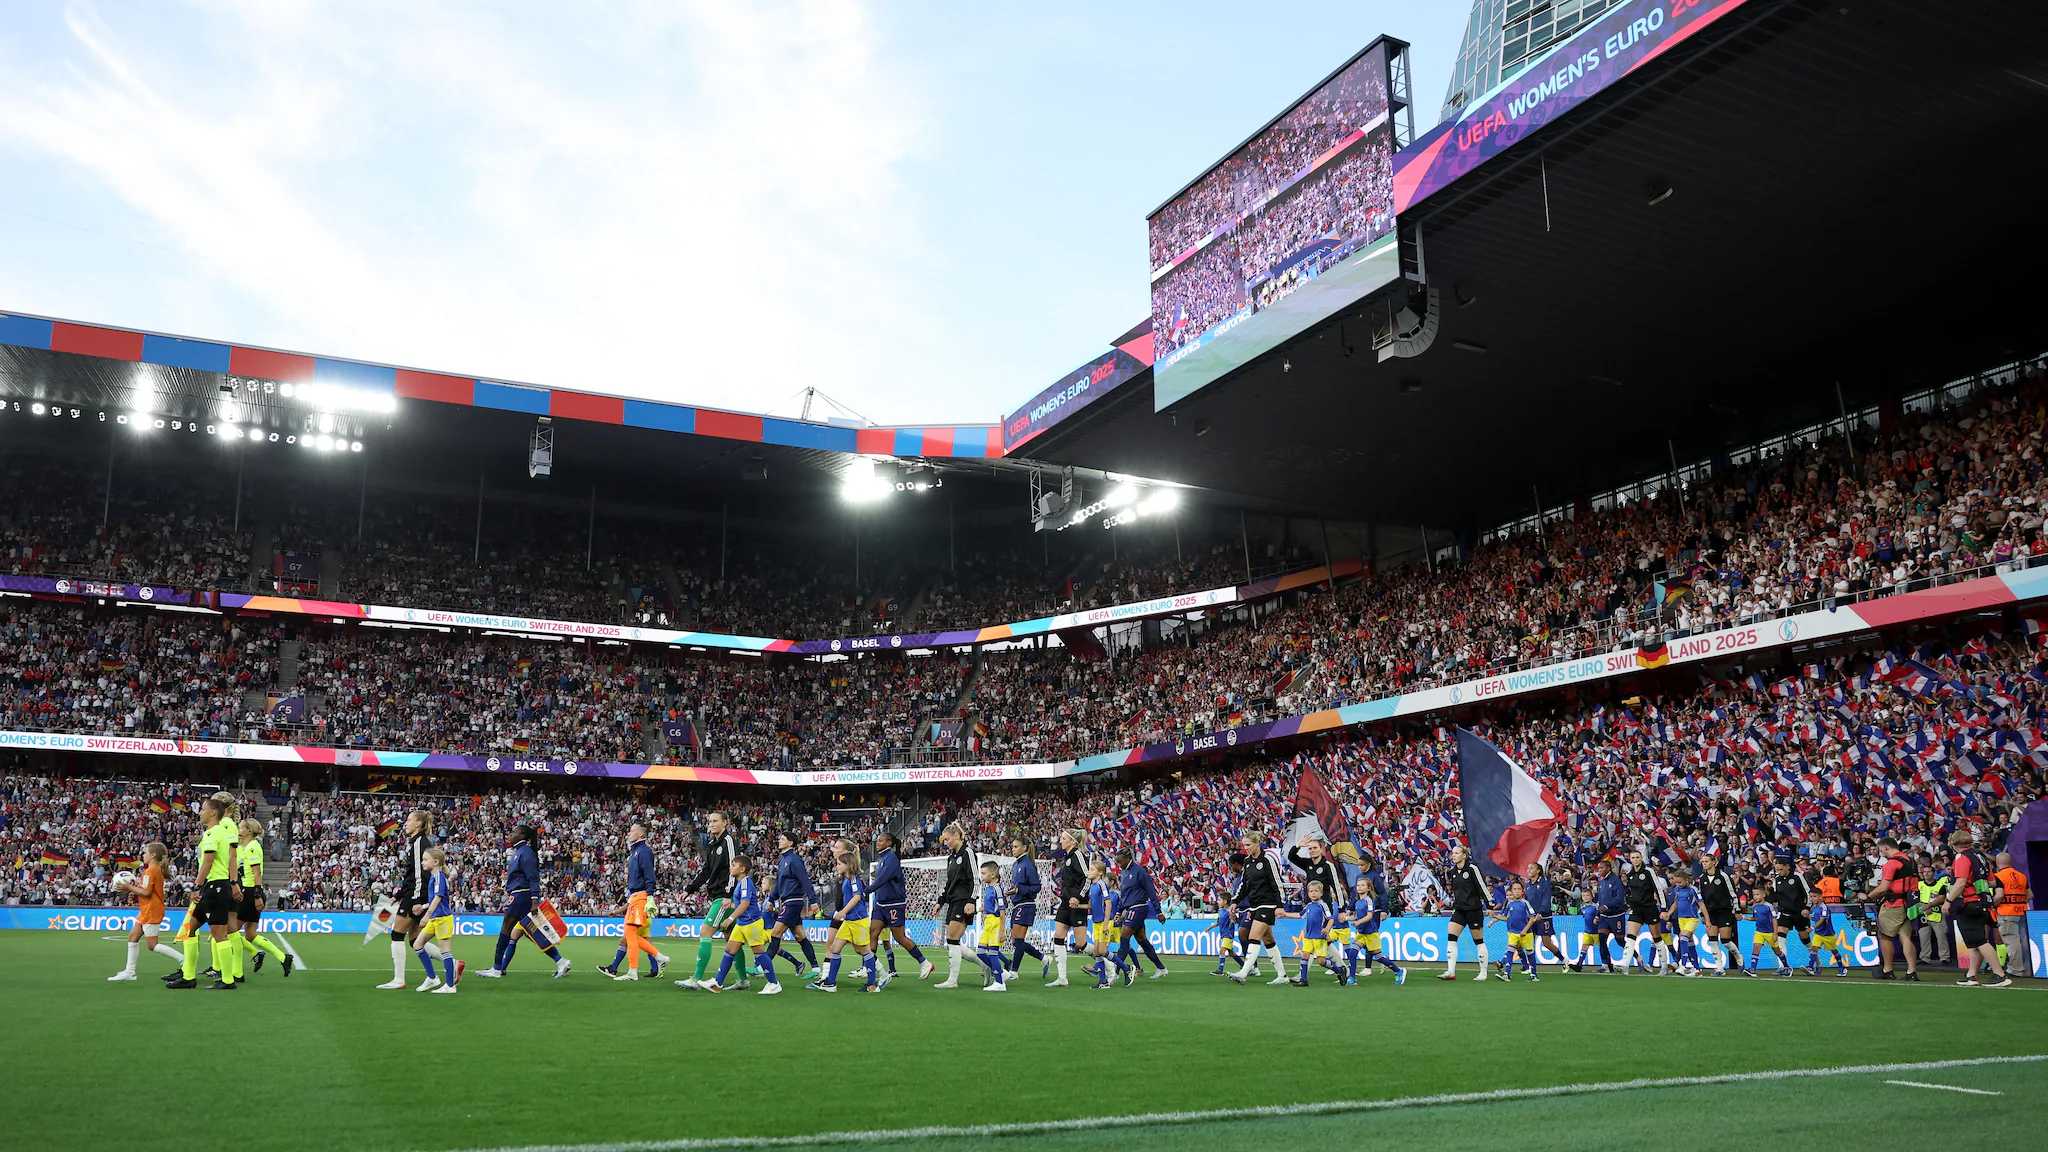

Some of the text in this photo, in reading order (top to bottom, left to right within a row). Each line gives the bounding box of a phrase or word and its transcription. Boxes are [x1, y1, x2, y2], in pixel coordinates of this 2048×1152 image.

[1458, 111, 1507, 151] UEFA
[1508, 48, 1600, 120] WOMEN'S
[1604, 7, 1664, 59] EURO
[1010, 360, 1115, 436] UEFA WOMEN'S EURO 2025
[290, 563, 302, 571] G7
[1088, 596, 1196, 621] UEFA WOMEN'S EURO 2025
[427, 613, 620, 636] UEFA WOMEN'S EURO SWITZERLAND 2025
[852, 639, 880, 648] BASEL
[1475, 680, 1507, 697] UEFA
[1508, 668, 1565, 690] WOMEN'S
[1568, 660, 1603, 679] EURO
[1715, 629, 1758, 651] 2025
[669, 729, 681, 737] C6
[941, 730, 952, 738] D1
[0, 734, 46, 746] OMEN'S
[50, 736, 83, 748] EURO
[87, 738, 174, 752] SWITZERLAND
[1193, 736, 1218, 750] BASEL
[514, 760, 550, 772] BASEL
[812, 768, 1003, 783] UEFA WOMEN'S EURO SWITZERLAND 2025
[889, 909, 898, 920] 12
[1127, 910, 1136, 920] 11
[64, 915, 170, 931] eurons
[258, 914, 333, 933] ronics
